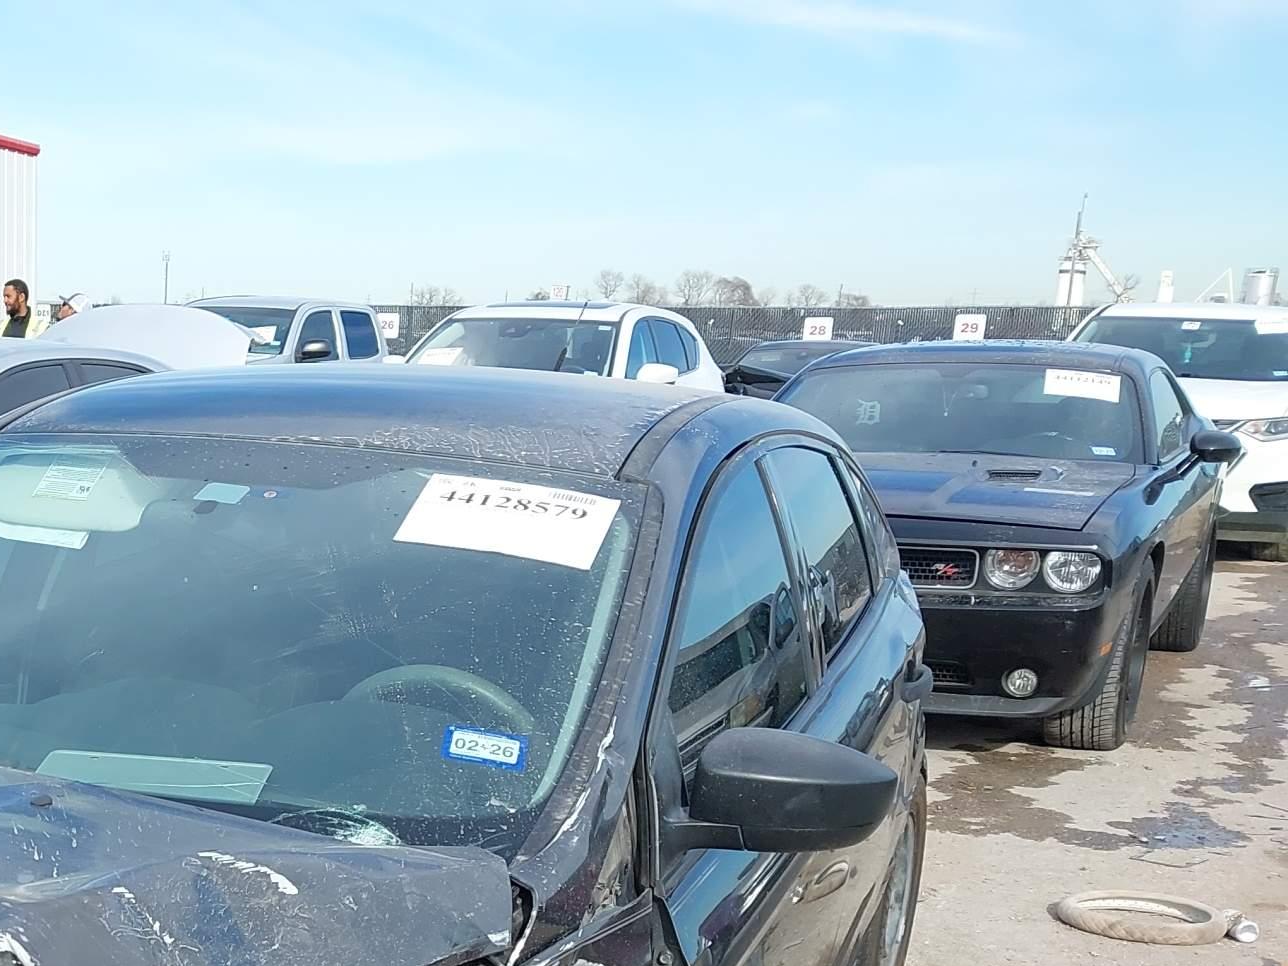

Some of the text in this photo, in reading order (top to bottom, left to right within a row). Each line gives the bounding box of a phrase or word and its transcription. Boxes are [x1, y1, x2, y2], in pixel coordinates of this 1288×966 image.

[382, 320, 394, 330] 26
[809, 325, 826, 336] 28
[961, 322, 979, 333] 29
[440, 490, 588, 519] 44128579
